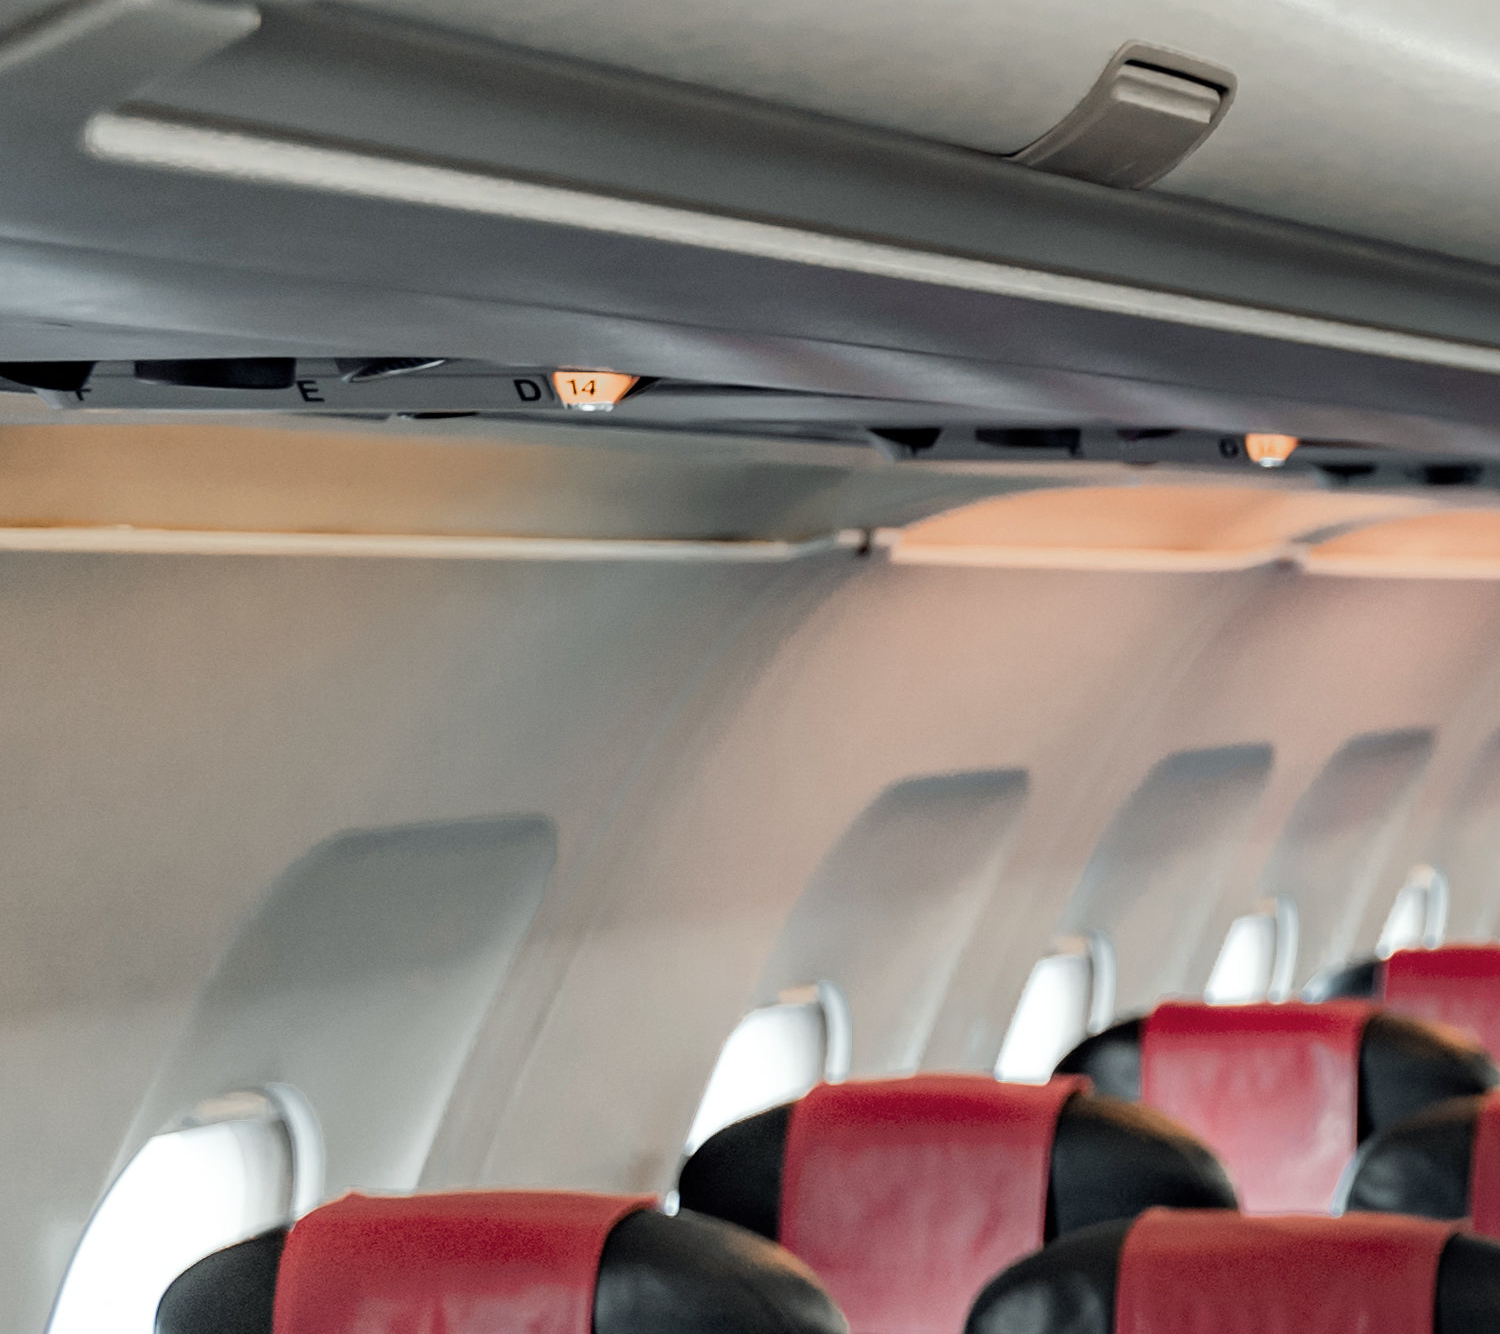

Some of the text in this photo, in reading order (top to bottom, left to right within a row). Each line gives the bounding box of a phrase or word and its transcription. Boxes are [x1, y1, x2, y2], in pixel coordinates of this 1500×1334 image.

[296, 380, 325, 402] E
[513, 378, 542, 402] D
[566, 378, 597, 396] 14
